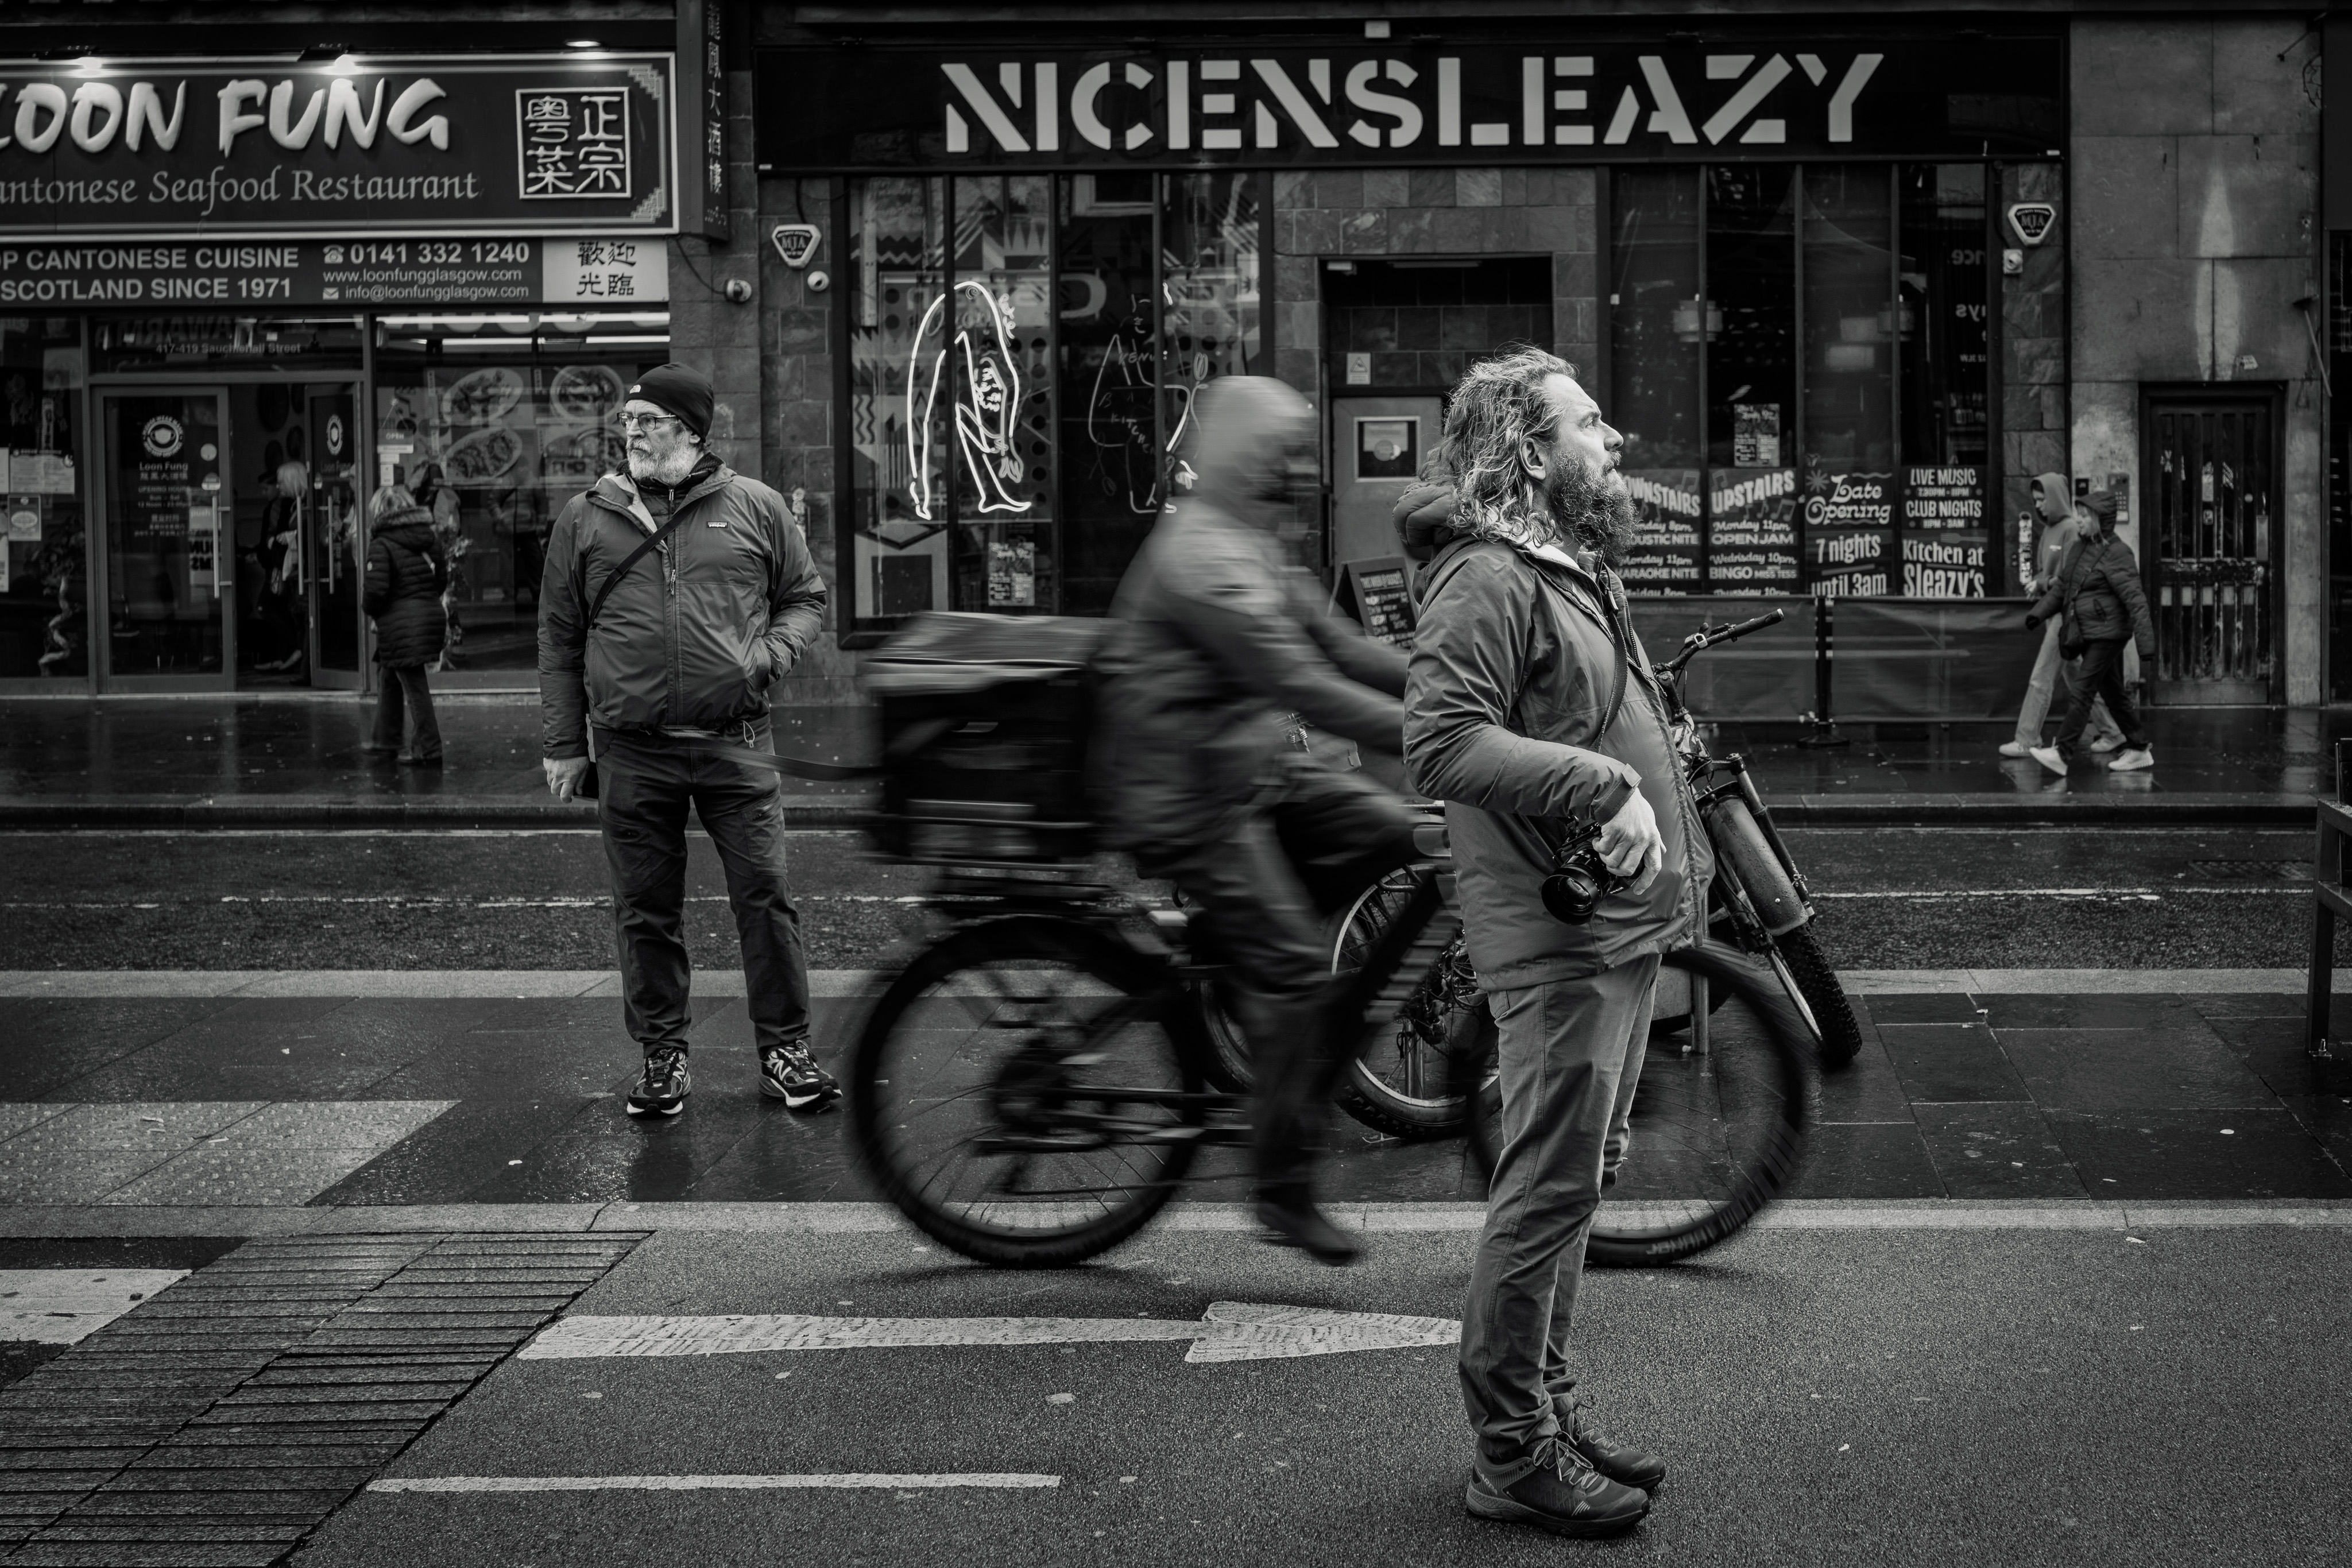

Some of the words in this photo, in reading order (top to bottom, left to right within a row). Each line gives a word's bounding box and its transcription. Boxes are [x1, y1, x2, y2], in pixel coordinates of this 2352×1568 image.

[218, 78, 448, 158] FUNG
[148, 165, 282, 216] Seafood
[291, 171, 479, 201] Restaurant
[2021, 214, 2045, 229] MJA
[782, 236, 806, 251] MJA
[26, 249, 187, 271] CANTONESE
[195, 248, 299, 269] CUISINE
[350, 244, 407, 265] 0141
[418, 243, 462, 264] 332
[471, 243, 529, 263] 1240
[323, 268, 521, 285] www.loonfungglasgow.com
[1, 278, 142, 301] SCOTLAND
[151, 277, 229, 299] SINCE
[238, 277, 290, 298] 1971
[346, 285, 528, 302] info@loonfungglasgow.com
[156, 343, 198, 354] 417-419
[202, 342, 265, 354] Sauchiehall
[268, 342, 301, 354] Street
[385, 432, 404, 440] OPEN
[139, 461, 163, 471] Loon
[165, 461, 188, 471] Fung
[1910, 468, 1935, 486] LIVE
[1937, 468, 1976, 486] MUSIC
[1619, 473, 1701, 517] OWNSTAIRS
[1711, 470, 1795, 514] UPSTAIRS
[1829, 474, 1882, 504] Late
[1805, 495, 1892, 525] Opening
[1906, 499, 1937, 518] CLUB
[1939, 499, 1982, 518] NIGHTS
[1712, 519, 1760, 532] Monday
[1672, 533, 1699, 545] NITE
[1711, 533, 1759, 545] OPEN
[1759, 533, 1794, 545] JAM
[1816, 538, 1826, 564] 7
[1828, 533, 1881, 564] nights
[1902, 539, 1963, 564] Kitchen
[1967, 547, 1984, 567] at
[1672, 567, 1699, 579] NITE
[1709, 566, 1753, 579] BINGO
[1903, 563, 1984, 598] Sleazy's
[1811, 574, 1849, 597] until
[1852, 572, 1887, 597] 3am
